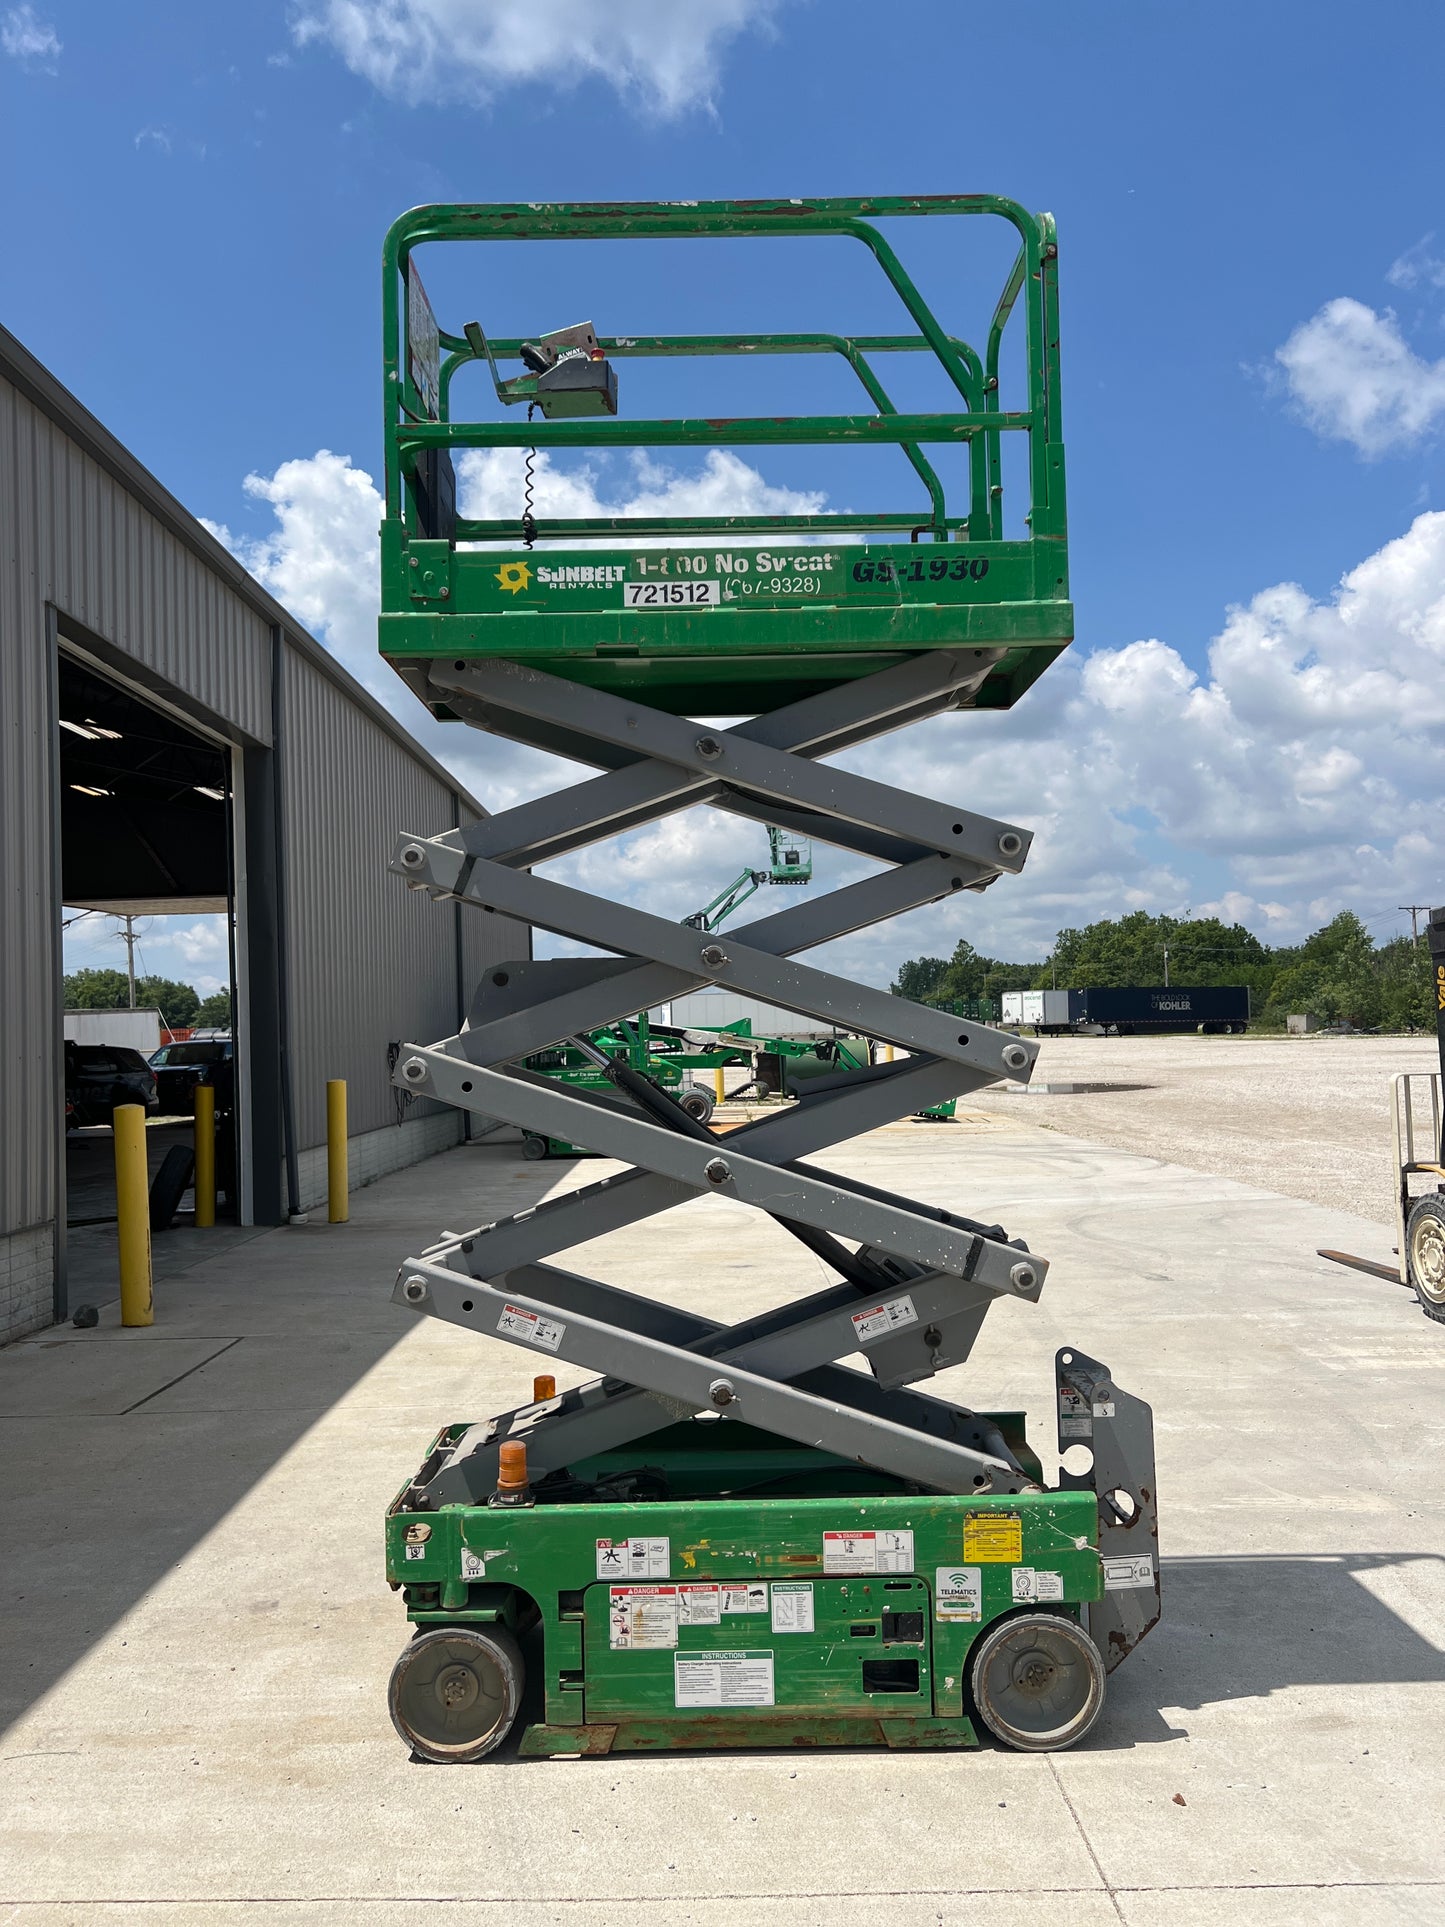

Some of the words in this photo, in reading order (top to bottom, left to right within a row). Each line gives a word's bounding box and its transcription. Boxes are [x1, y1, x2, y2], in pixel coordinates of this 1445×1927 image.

[537, 566, 626, 582] SUNBELT
[715, 554, 749, 574] No
[852, 555, 990, 583] GS-1930
[629, 583, 710, 604] 721512
[1159, 1001, 1191, 1010] KOHLER
